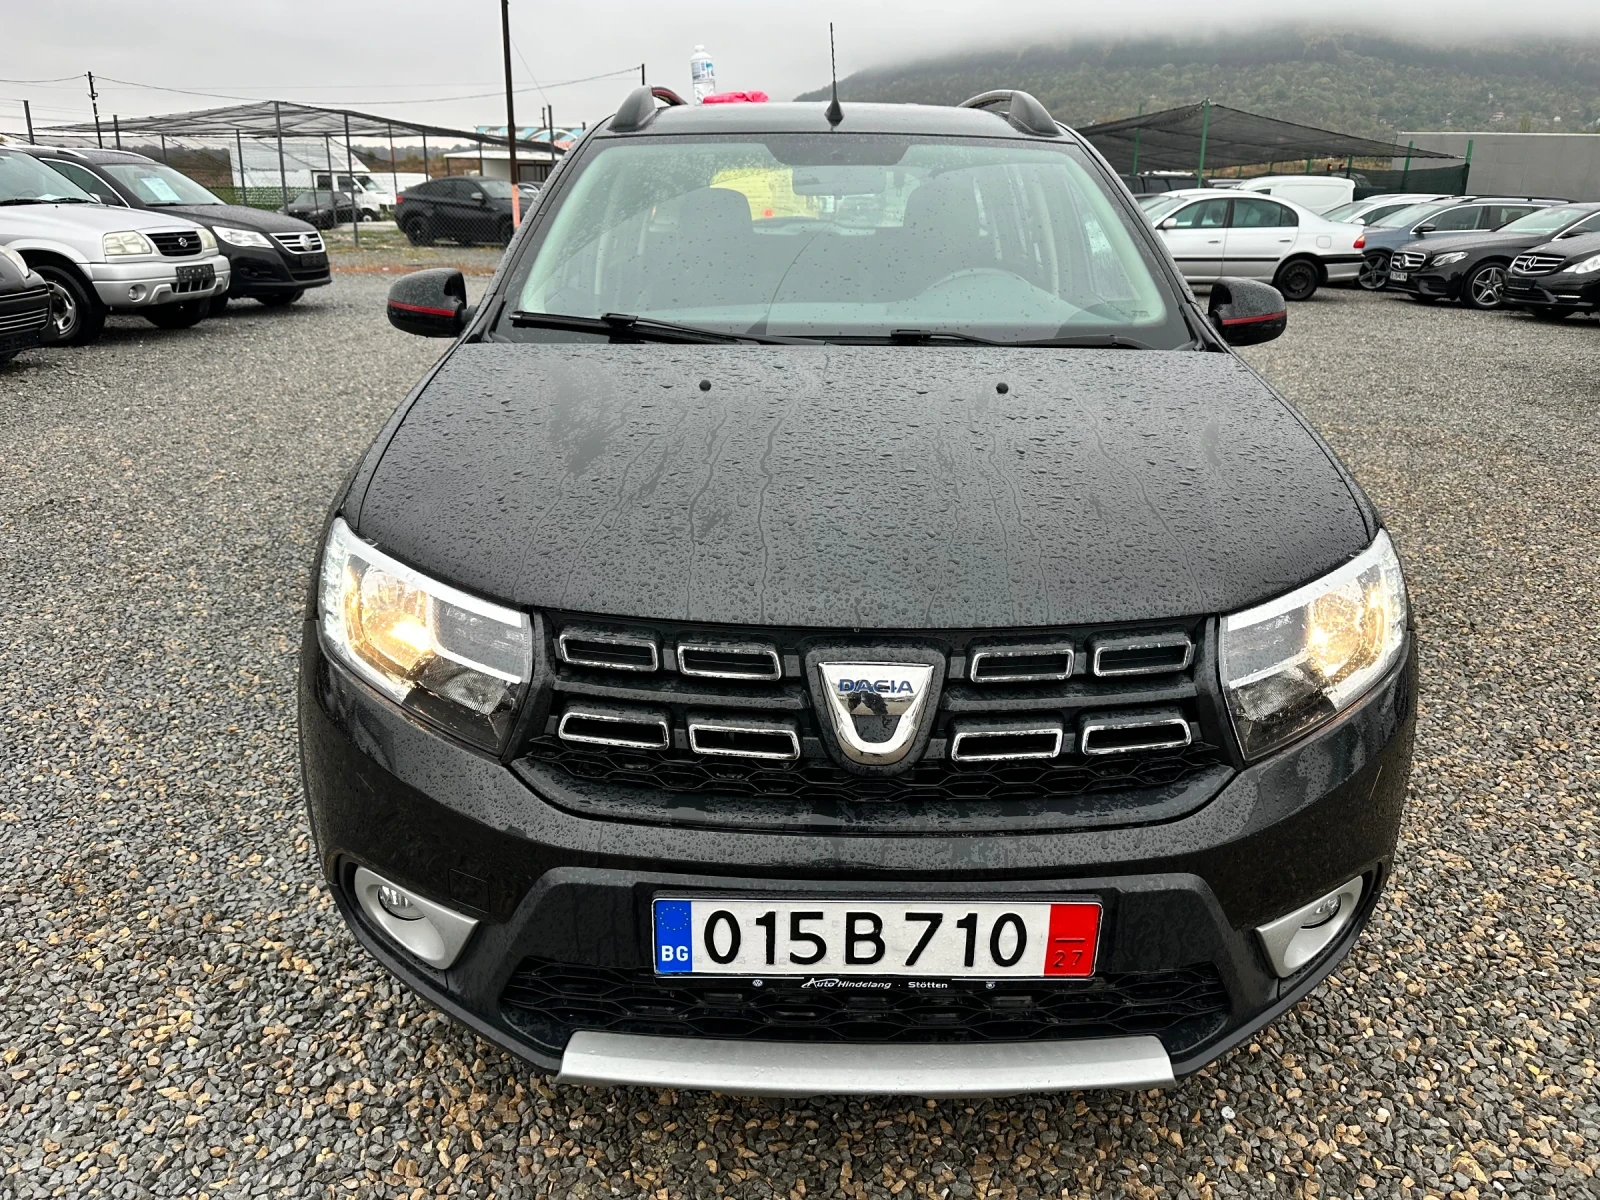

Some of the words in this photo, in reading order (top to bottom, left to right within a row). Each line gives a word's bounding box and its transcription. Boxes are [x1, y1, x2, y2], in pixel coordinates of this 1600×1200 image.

[839, 678, 914, 693] DACIA
[661, 945, 689, 962] BG
[1053, 949, 1083, 967] 27
[801, 977, 839, 989] Auto
[837, 980, 892, 990] Hindelang
[907, 980, 948, 989] Stötten
